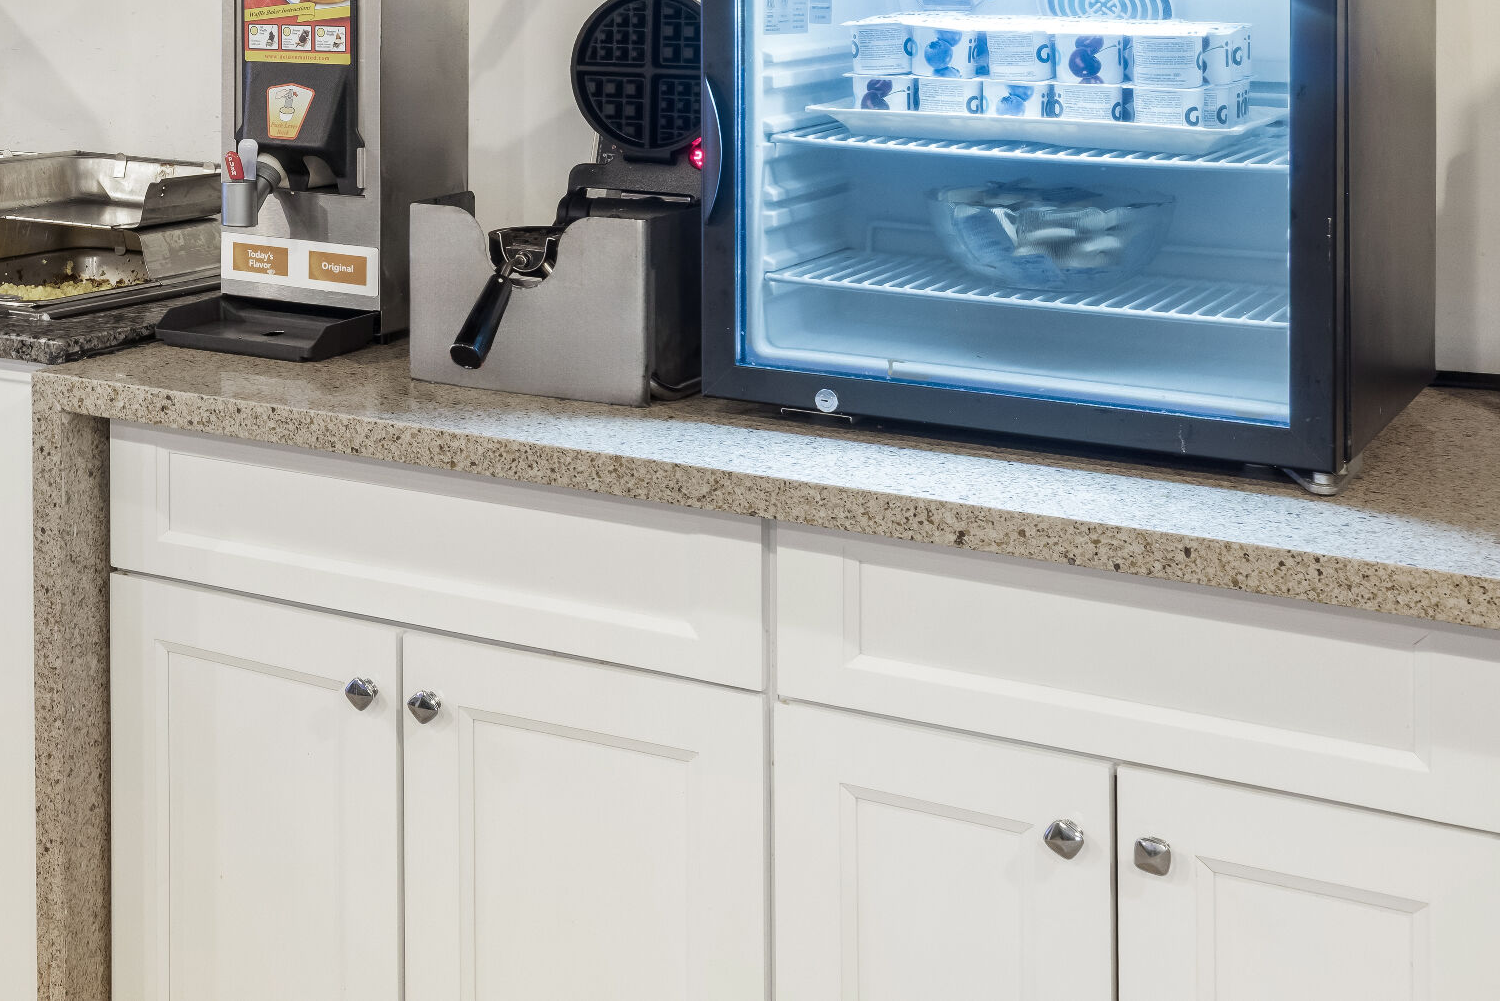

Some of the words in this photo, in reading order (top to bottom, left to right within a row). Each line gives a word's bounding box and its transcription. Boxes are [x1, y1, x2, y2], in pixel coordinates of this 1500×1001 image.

[249, 10, 266, 18] Waffle
[281, 5, 312, 14] Instructions
[247, 249, 274, 261] Today's
[249, 259, 271, 269] Flavor
[321, 261, 354, 273] Original
